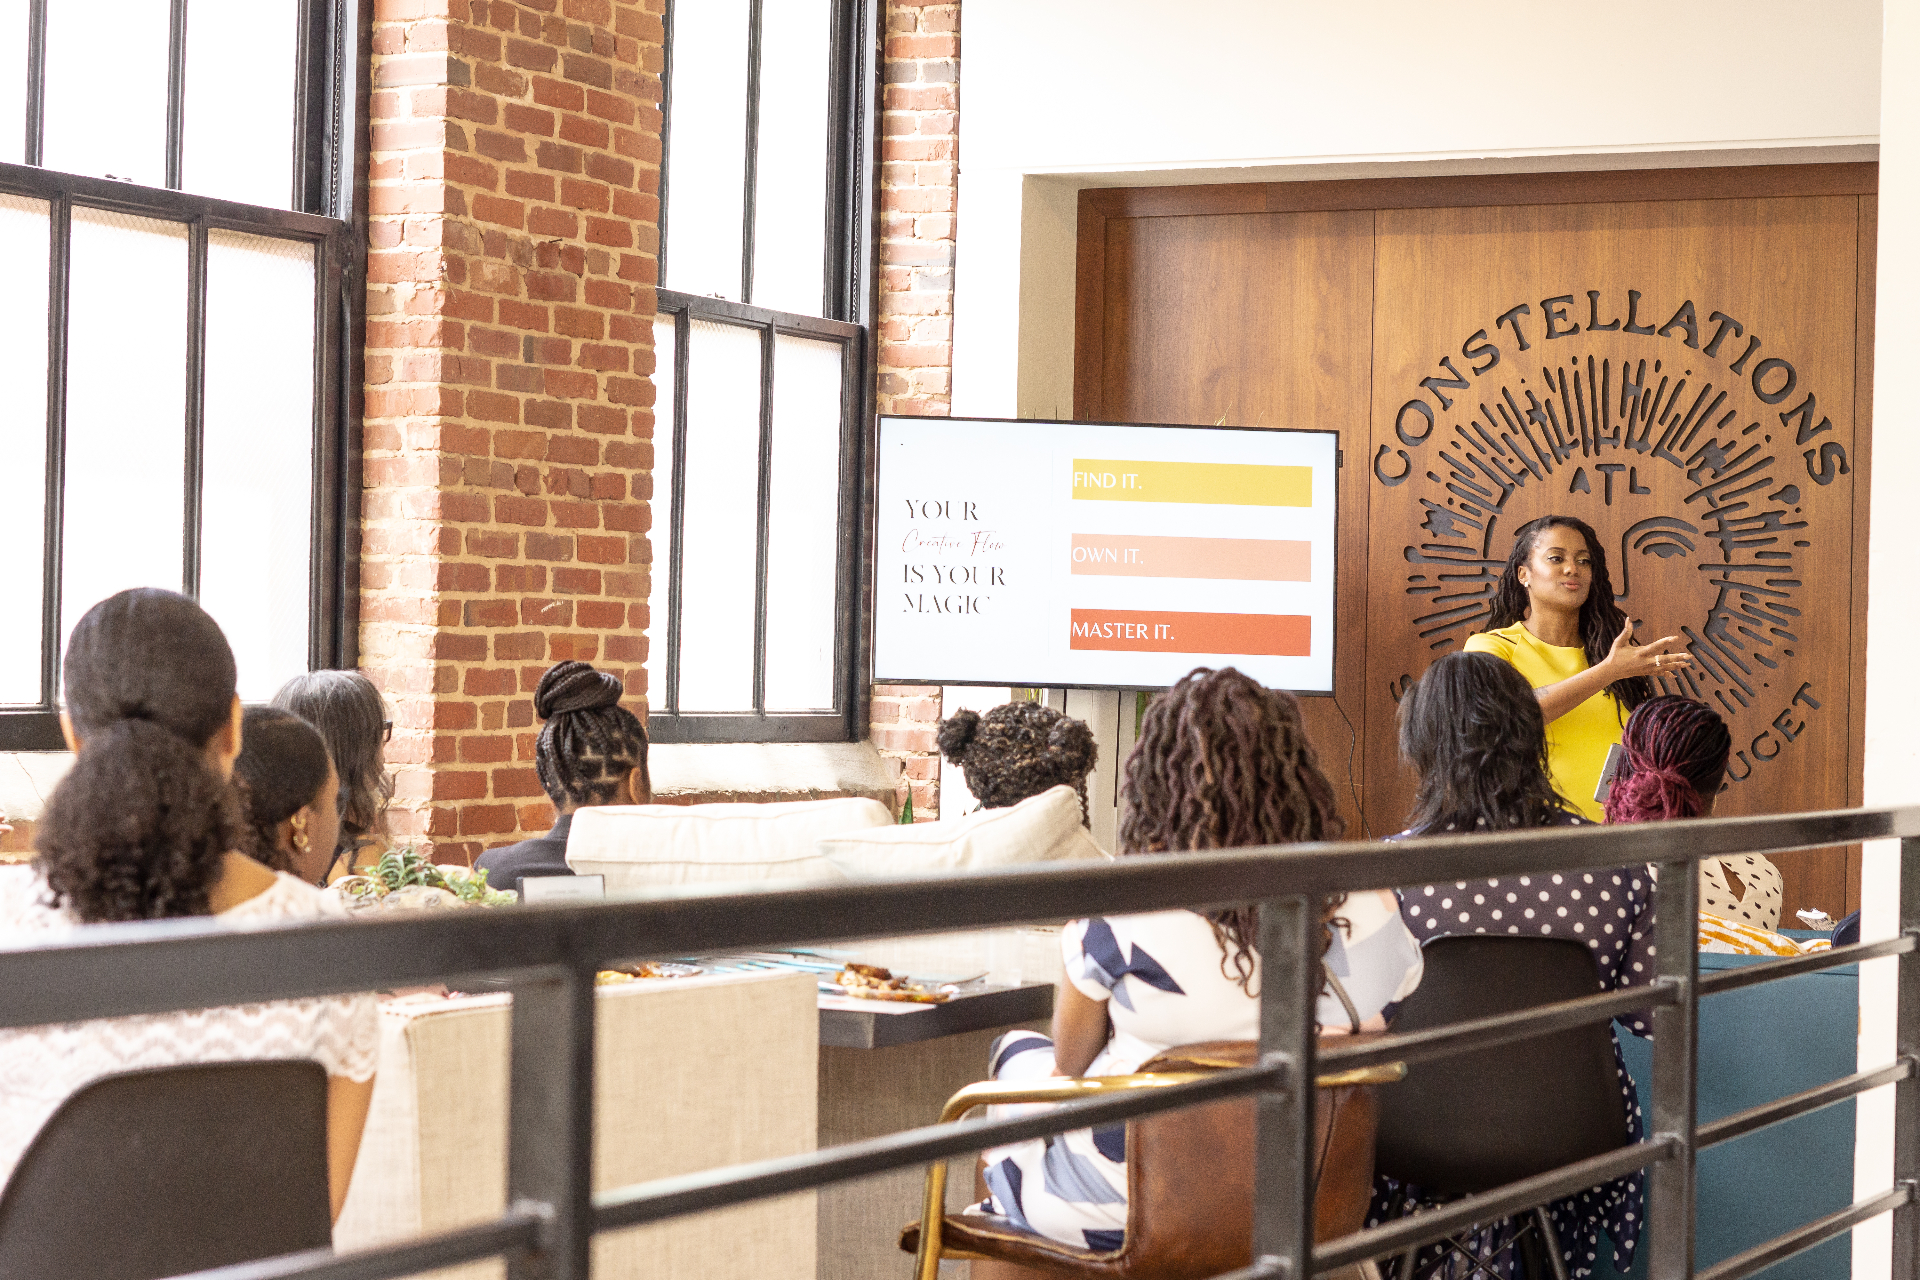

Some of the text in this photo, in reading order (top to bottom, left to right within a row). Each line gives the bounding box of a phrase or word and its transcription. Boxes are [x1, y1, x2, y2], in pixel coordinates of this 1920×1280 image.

[1373, 289, 1851, 487] CONSTELLATIONS
[1074, 471, 1143, 490] FIND IT.
[1569, 463, 1651, 507] ATL
[905, 499, 979, 520] YOUR
[902, 528, 1006, 557] Creative Flow
[1072, 546, 1144, 565] OWN IT.
[904, 564, 1006, 587] IS YOUR
[903, 593, 991, 615] MAGIC
[1072, 621, 1175, 641] MASTER IT.
